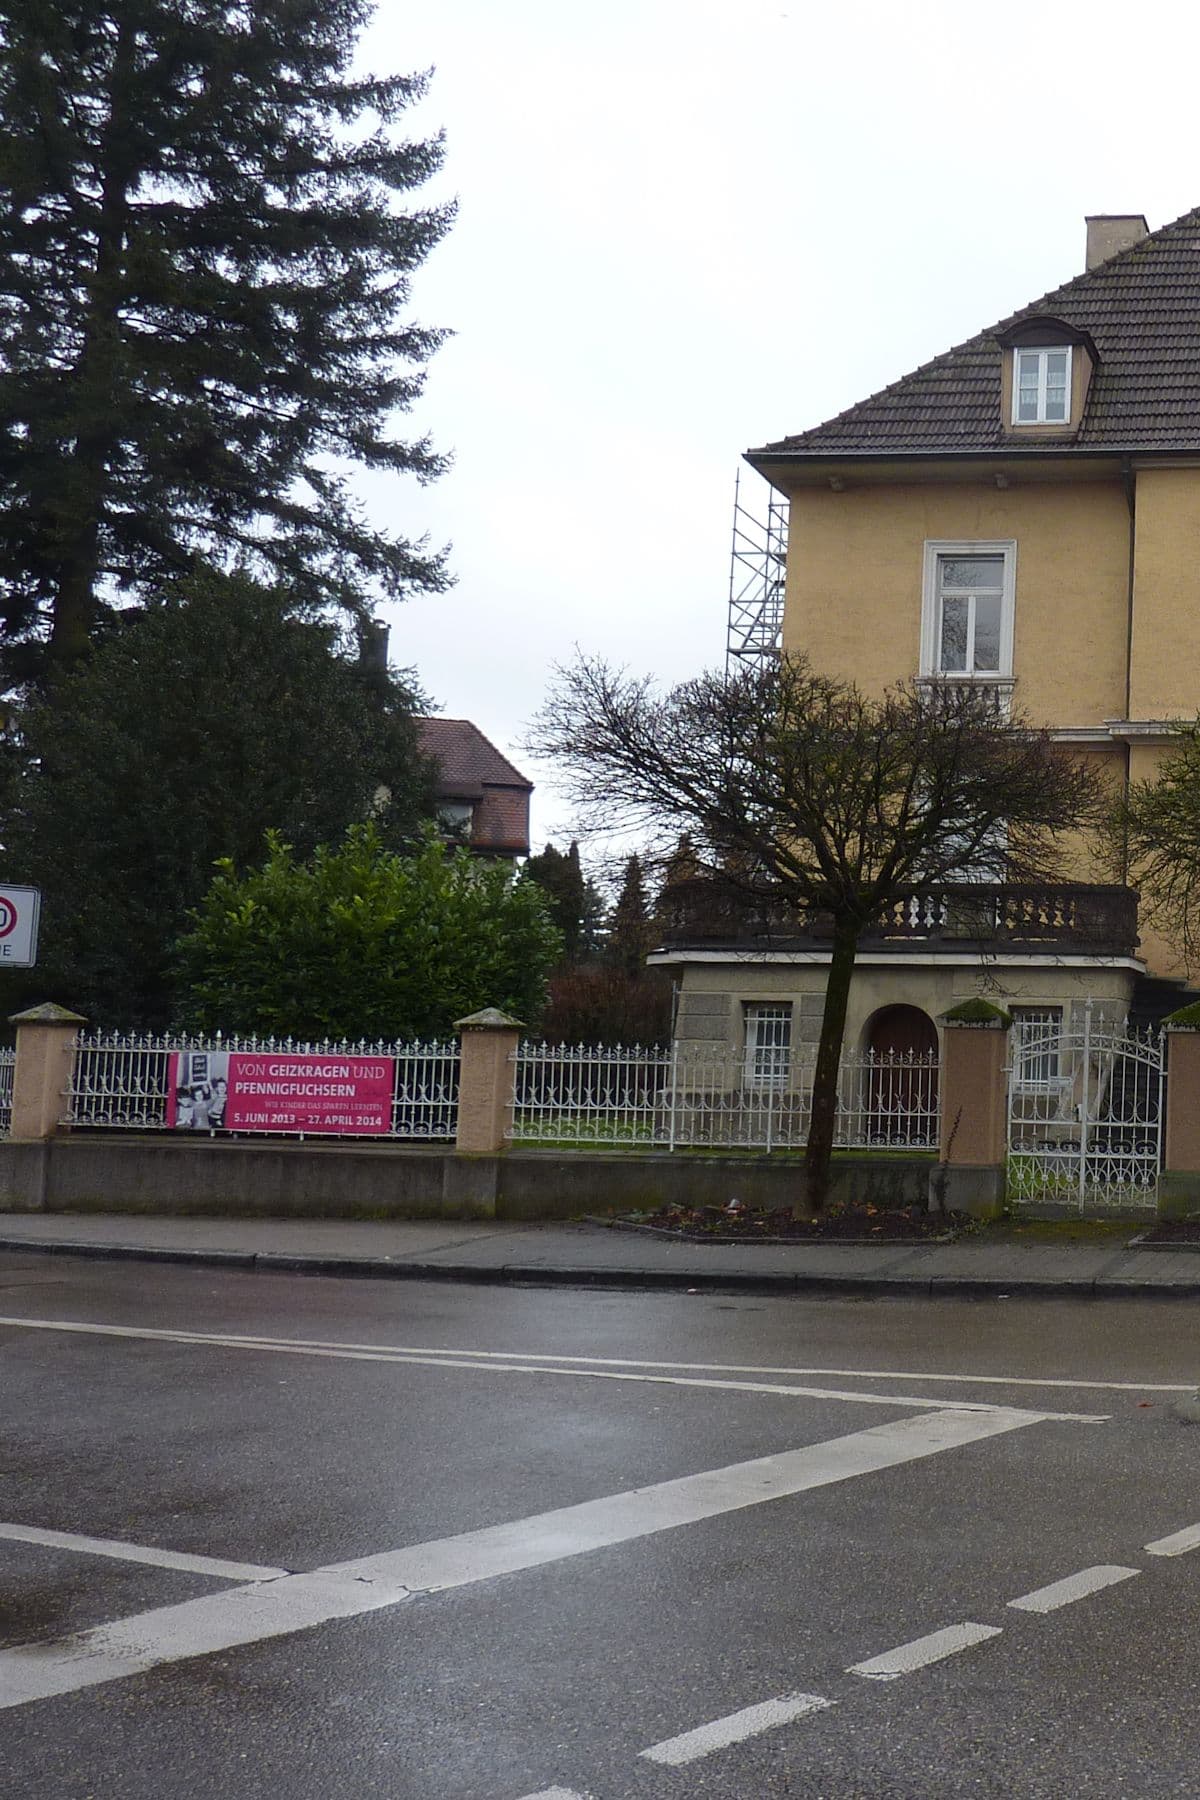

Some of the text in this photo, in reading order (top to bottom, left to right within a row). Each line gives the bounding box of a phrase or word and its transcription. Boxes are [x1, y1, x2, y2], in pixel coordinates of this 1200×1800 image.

[236, 1063, 385, 1079] VON GEIZKRAGEN UND
[235, 1082, 356, 1097] PFENNIGFUCHSERN
[280, 1101, 306, 1109] KINDER
[307, 1102, 321, 1110] DAS
[322, 1102, 349, 1110] SPAREN
[234, 1113, 244, 1122] 5.
[245, 1113, 269, 1123] JUNI
[271, 1114, 296, 1124] 2013
[307, 1115, 322, 1125] 27.
[324, 1115, 354, 1126] APRIL
[356, 1116, 382, 1126] 2014
